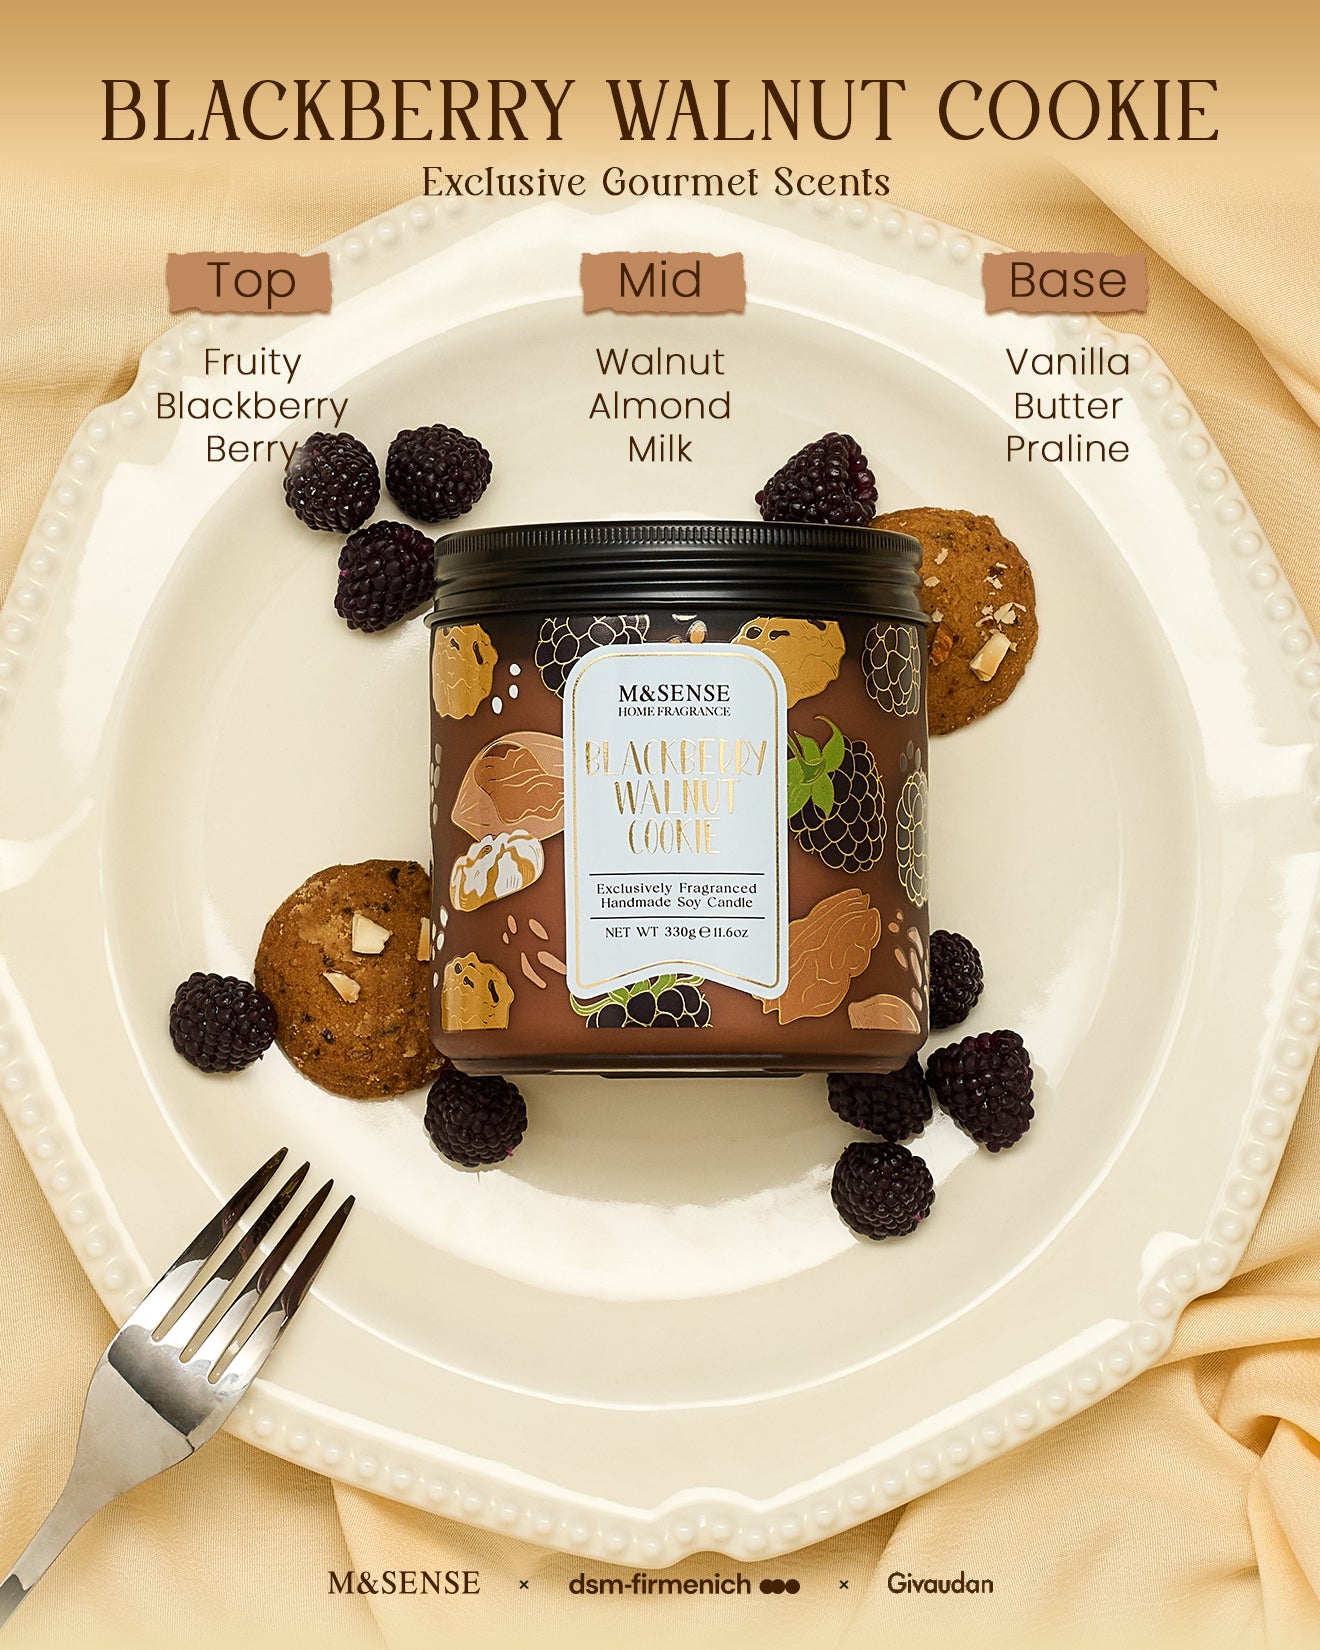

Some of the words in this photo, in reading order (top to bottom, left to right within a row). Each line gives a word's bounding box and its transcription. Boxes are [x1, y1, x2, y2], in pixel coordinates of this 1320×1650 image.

[618, 684, 731, 703] M&SENSE
[618, 706, 655, 717] HOME
[657, 706, 731, 717] FRAGRANCE
[585, 738, 767, 776] BLACKBERRY
[614, 778, 741, 815] WALNUT
[628, 817, 721, 854] COOKIE
[596, 883, 673, 896] Exclusively
[679, 882, 757, 896] Fragranced
[601, 897, 672, 909] Handmade
[677, 896, 702, 910] Soy
[707, 896, 753, 909] Candle
[605, 926, 631, 938] NET
[636, 926, 659, 938] WT
